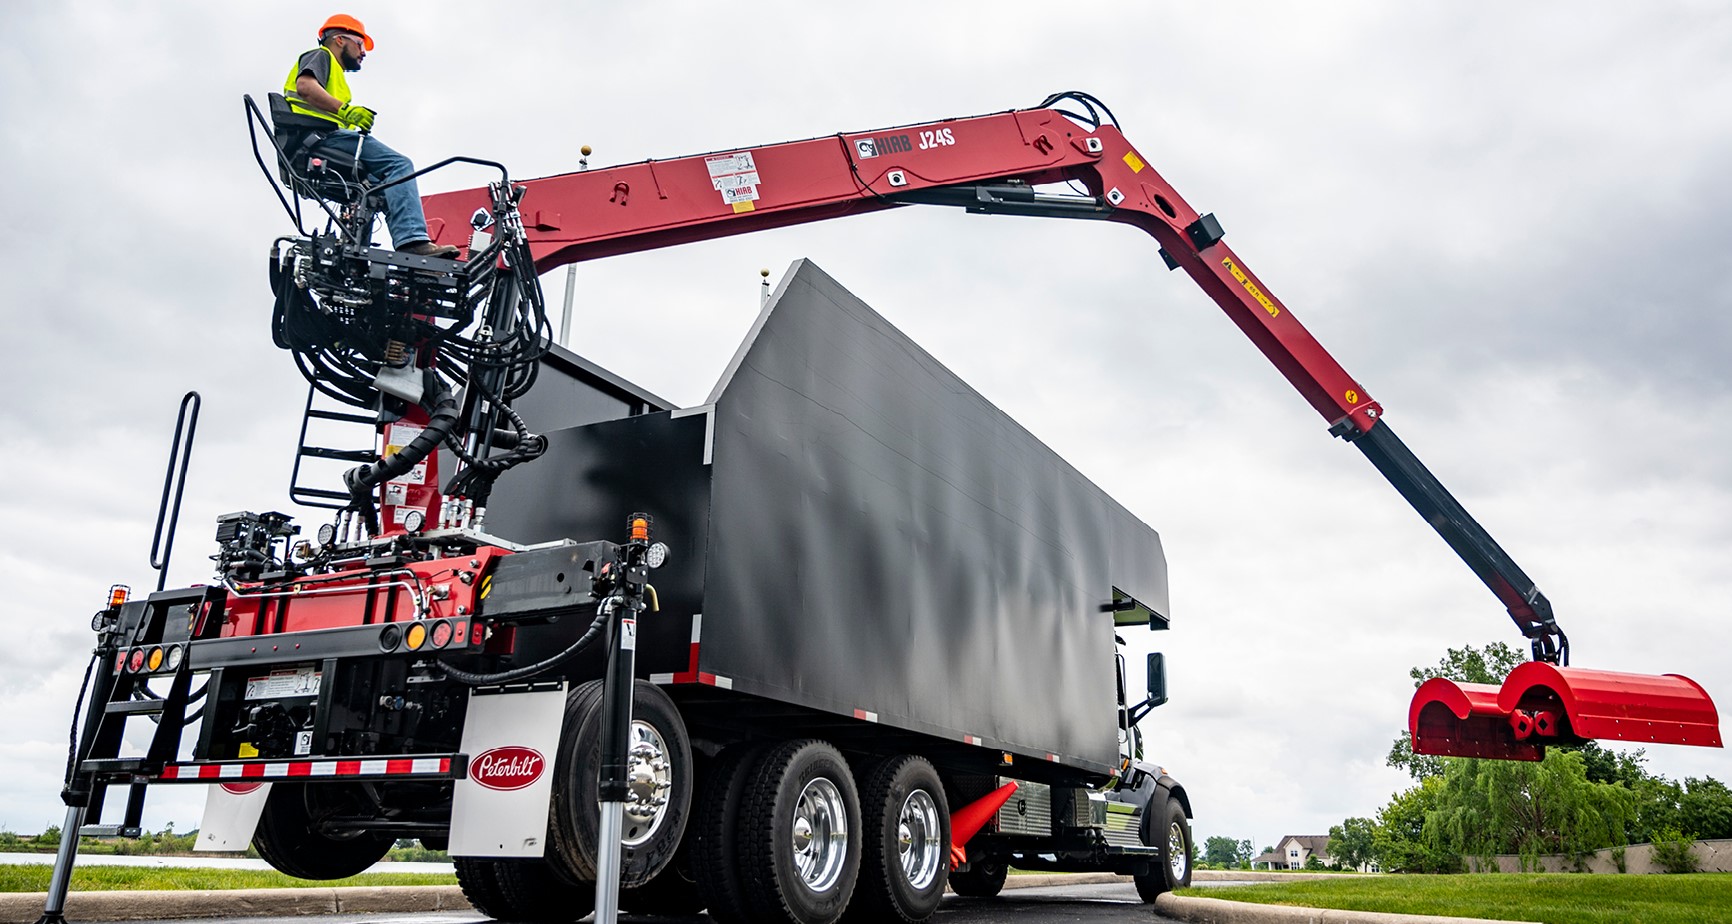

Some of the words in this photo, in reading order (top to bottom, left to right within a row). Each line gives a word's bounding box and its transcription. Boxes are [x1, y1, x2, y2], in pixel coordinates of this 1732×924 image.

[875, 135, 913, 155] HIAB
[918, 128, 956, 150] J24S
[735, 186, 753, 196] HIAB
[478, 754, 541, 779] Peterbilt
